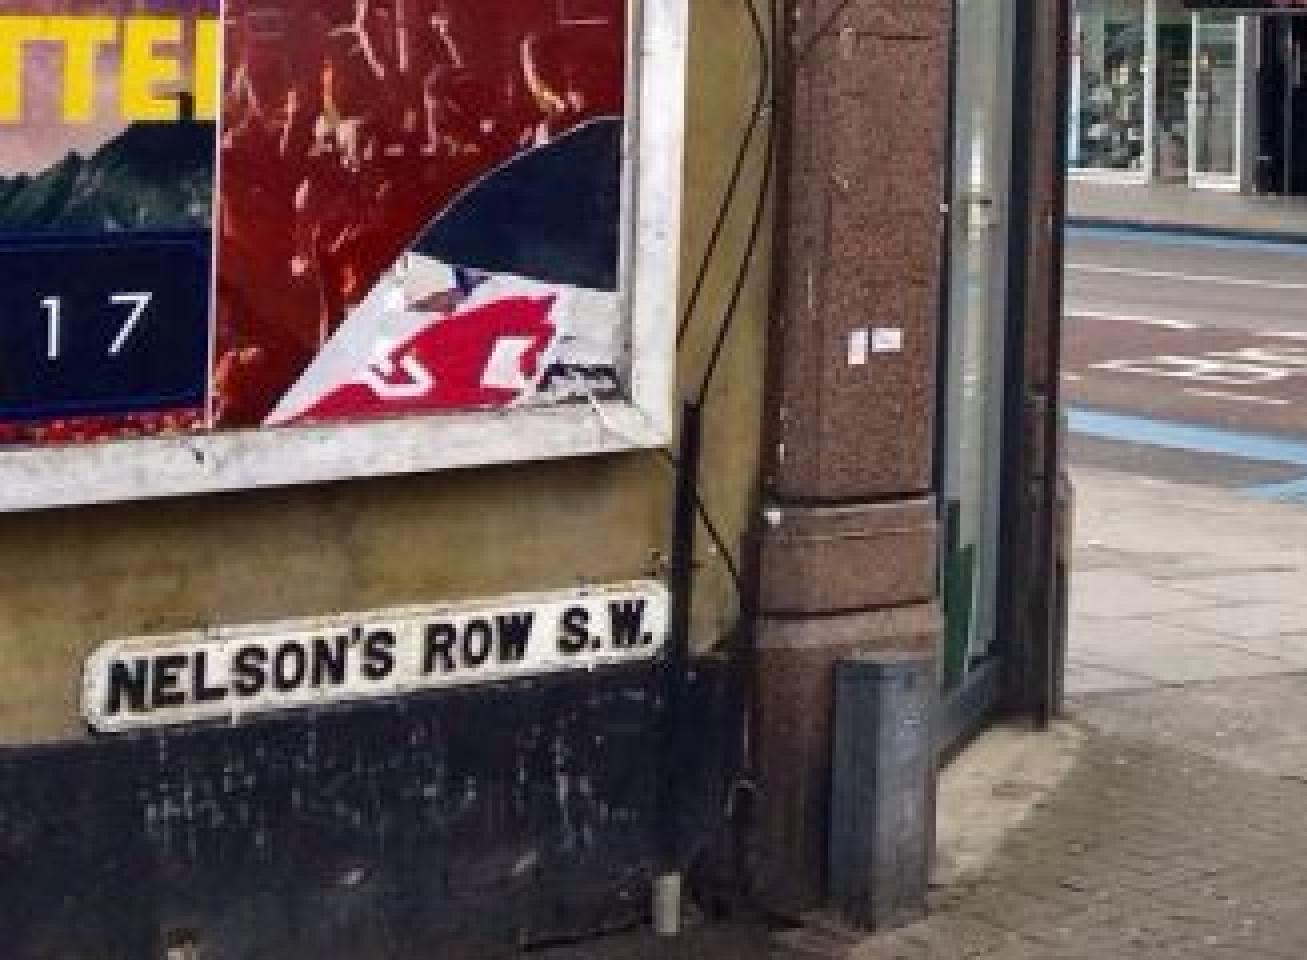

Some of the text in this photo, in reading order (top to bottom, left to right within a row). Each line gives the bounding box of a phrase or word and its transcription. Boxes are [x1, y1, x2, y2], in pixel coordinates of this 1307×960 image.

[106, 598, 652, 713] NELSON'S ROW S.W.
